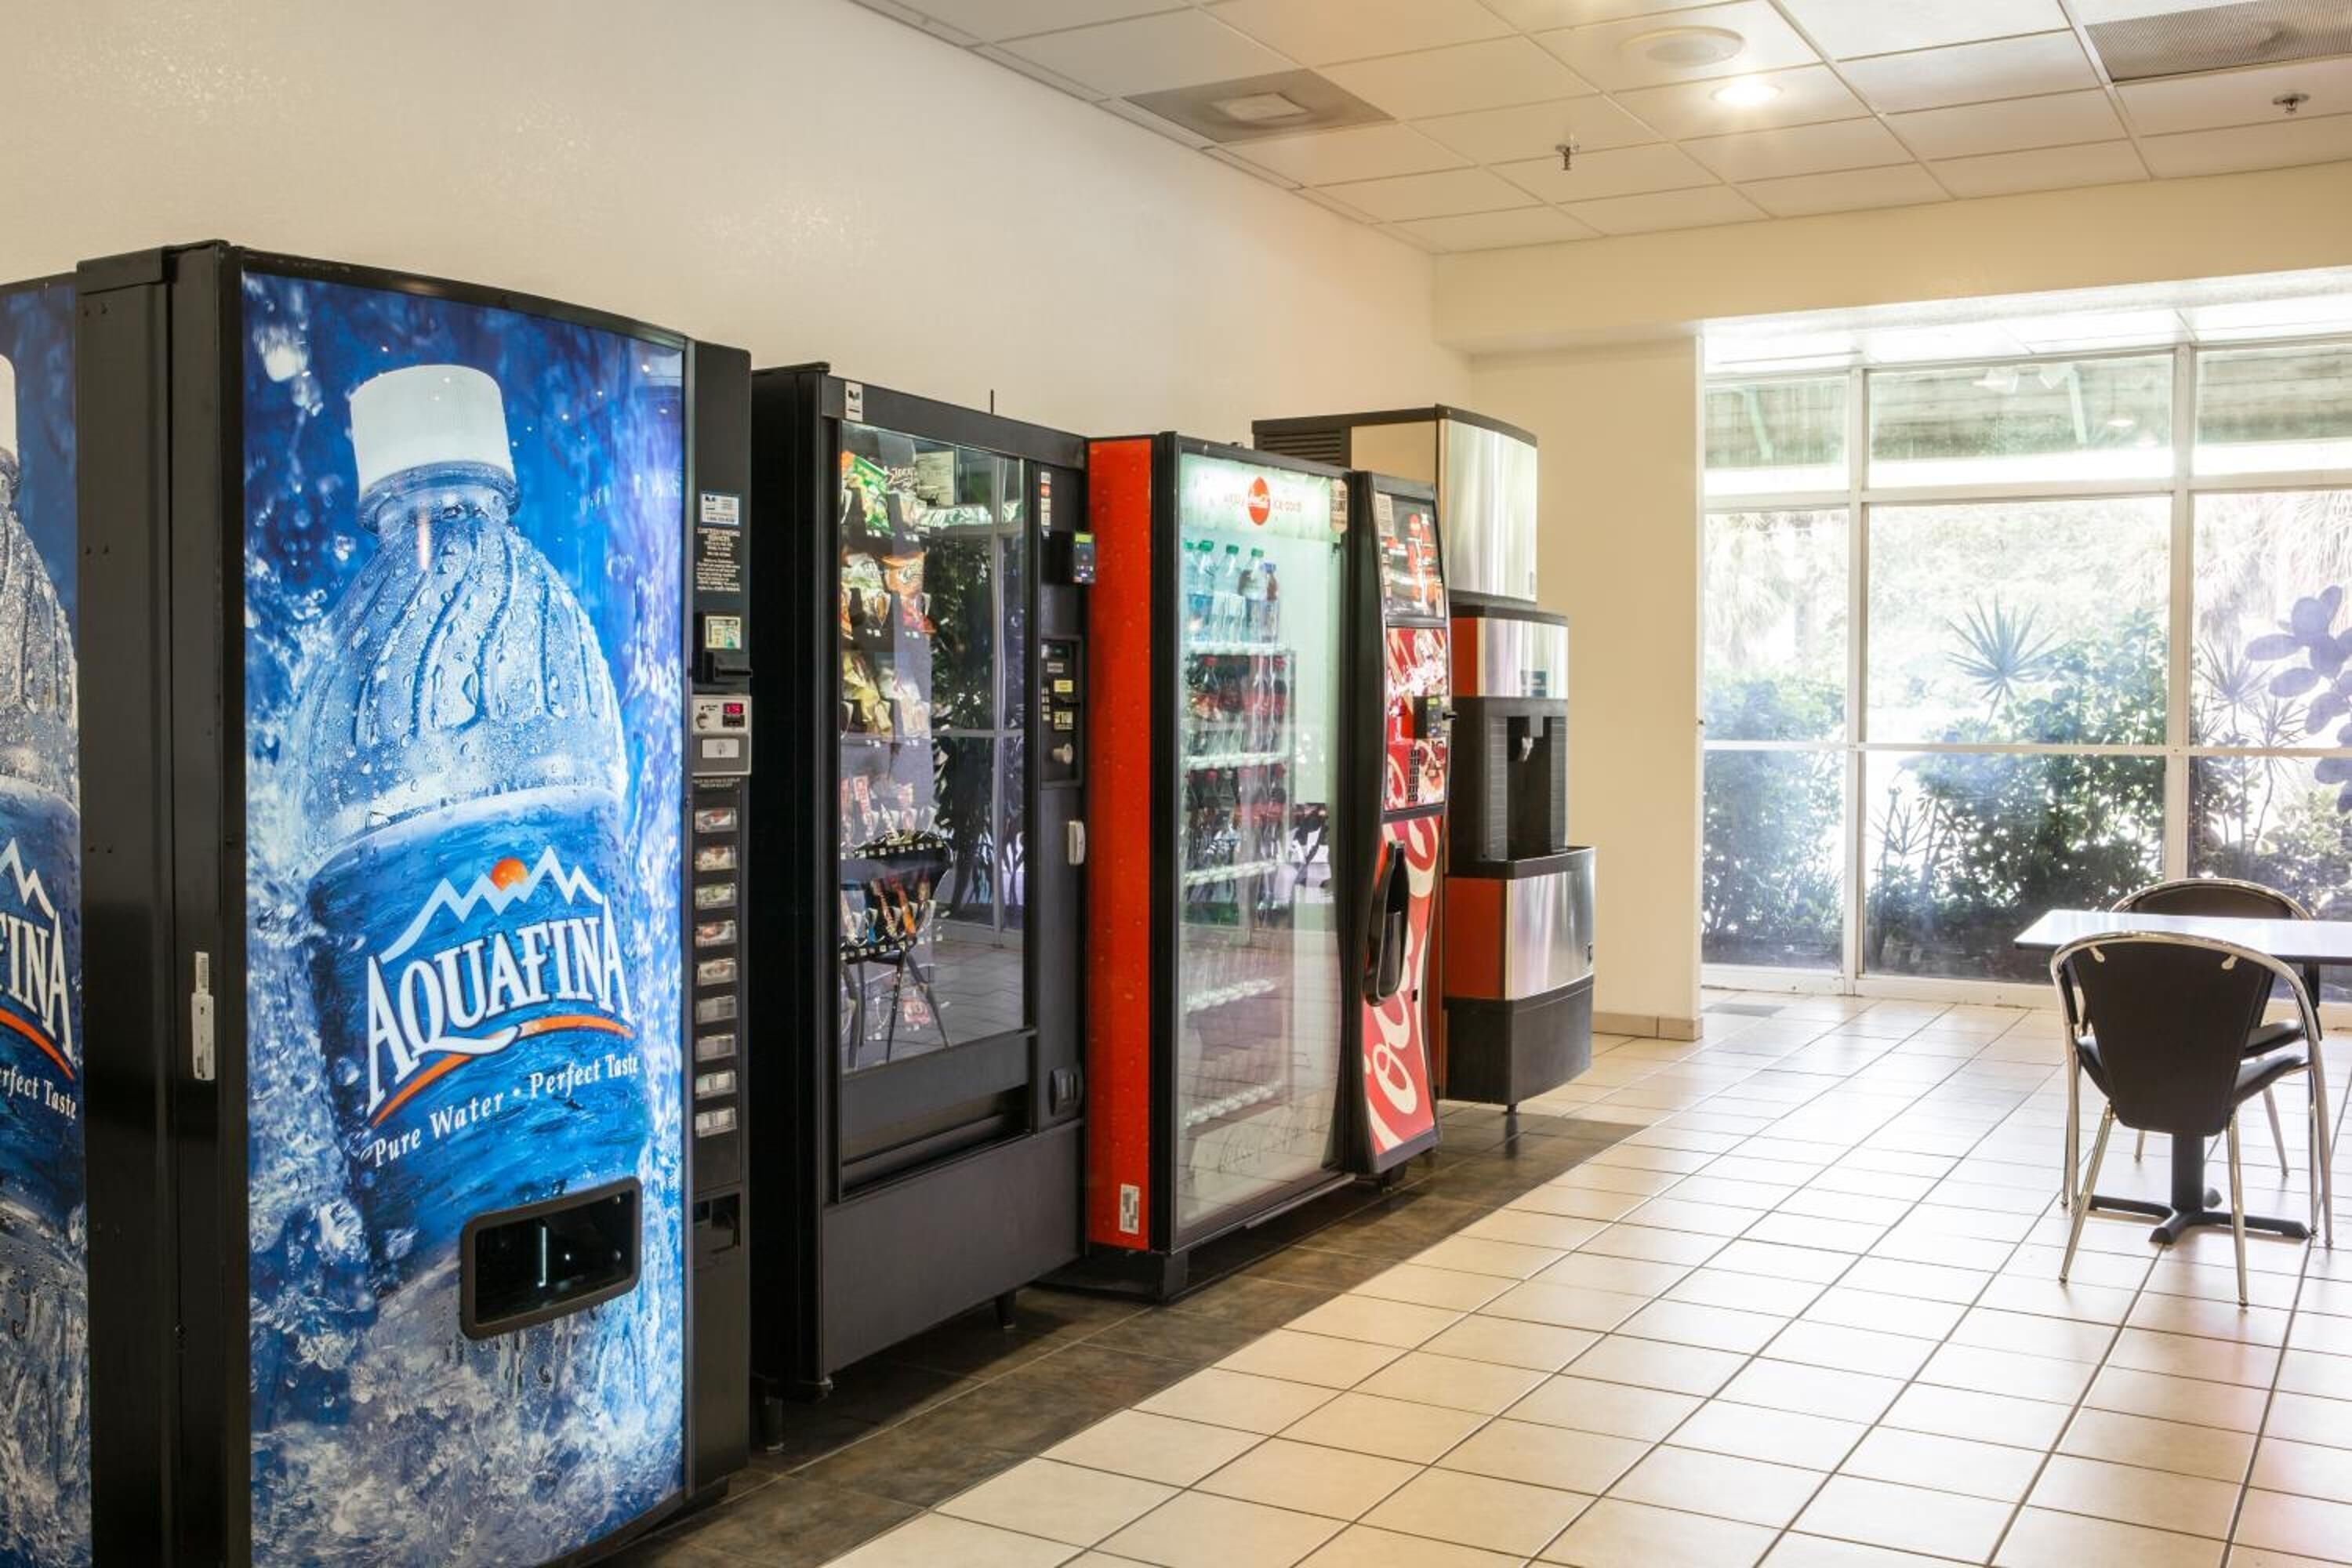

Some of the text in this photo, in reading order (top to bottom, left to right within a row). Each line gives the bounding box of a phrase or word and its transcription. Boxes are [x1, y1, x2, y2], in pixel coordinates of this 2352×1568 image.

[367, 894, 633, 1117] AQUAFINA
[0, 1065, 76, 1120] rfect Taste
[374, 1127, 422, 1167] Pure
[429, 1091, 505, 1140] Water
[530, 1060, 601, 1098] Perfect
